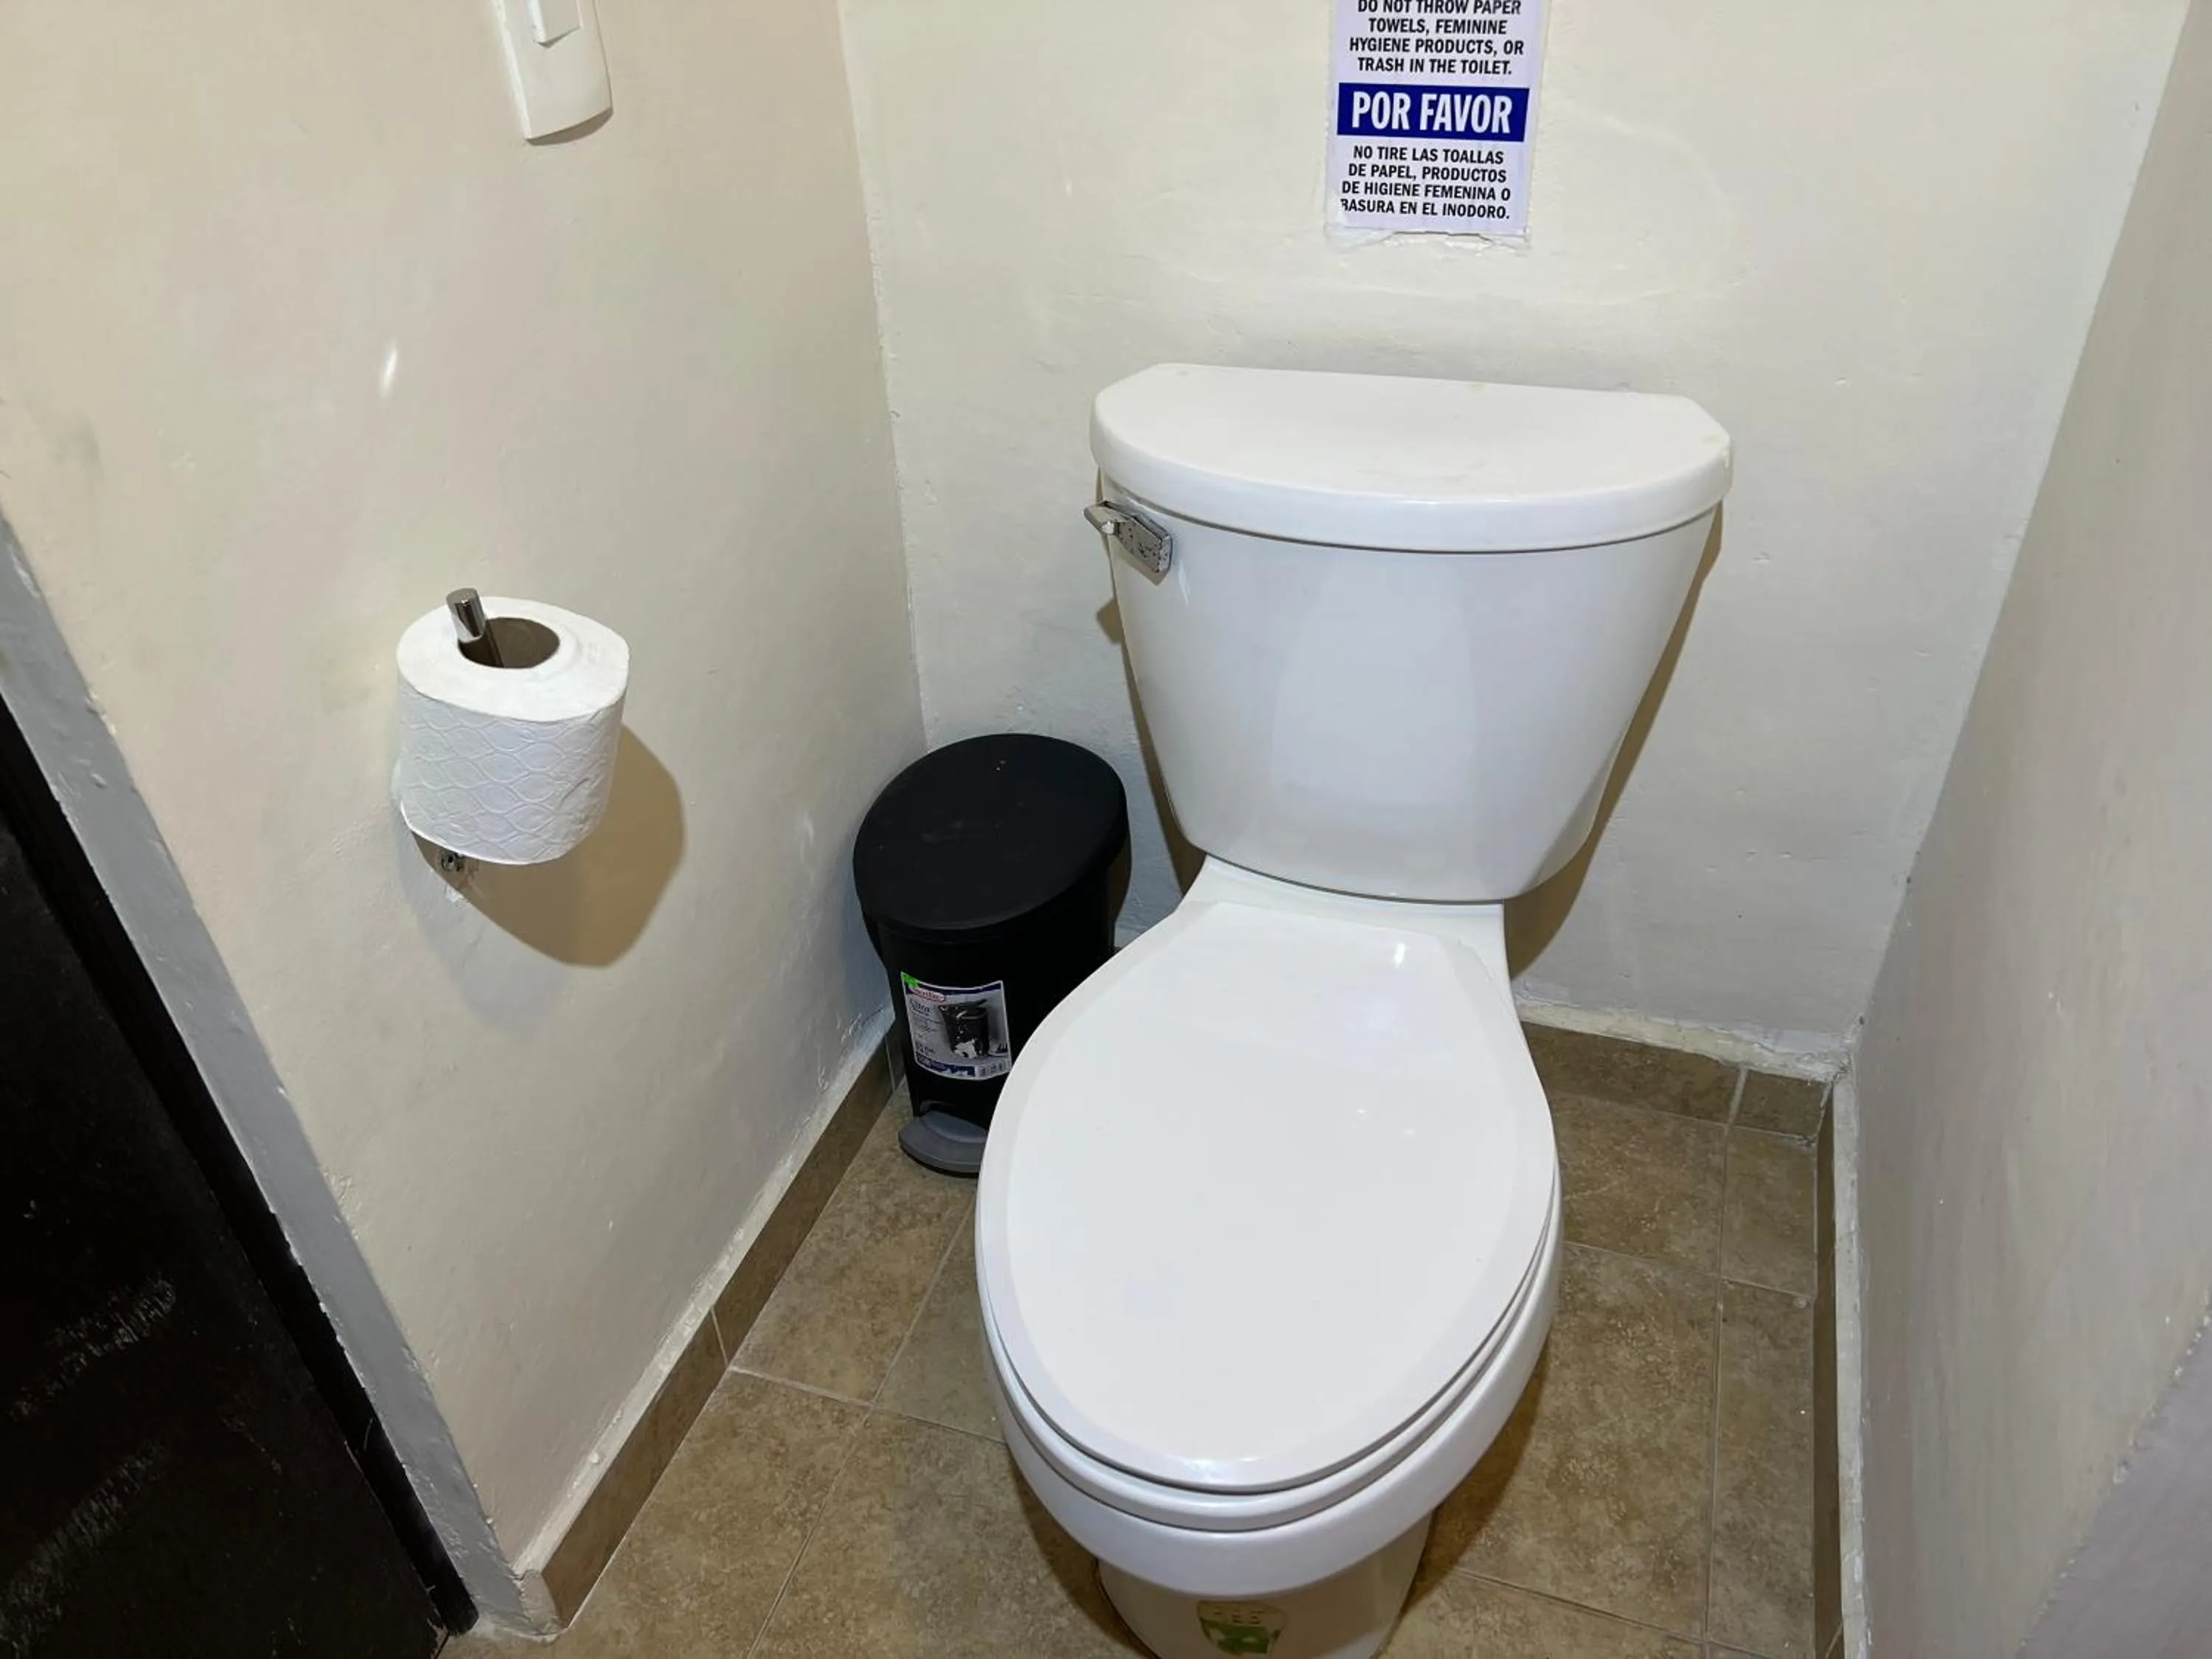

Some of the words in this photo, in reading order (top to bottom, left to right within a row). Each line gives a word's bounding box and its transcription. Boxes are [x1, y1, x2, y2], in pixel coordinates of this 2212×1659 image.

[1358, 0, 1377, 13] DO
[1383, 0, 1413, 13] NOT
[1416, 0, 1469, 14] THROW
[1473, 0, 1521, 15] PAPER
[1368, 17, 1430, 36] TOWELS,
[1436, 18, 1507, 35] FEMININE
[1349, 38, 1411, 52] HYGIENE
[1415, 38, 1498, 57] PRODUCTS,
[1503, 40, 1524, 55] OR
[1358, 57, 1404, 72] TRASH
[1409, 58, 1425, 73] IN
[1429, 59, 1456, 74] THE
[1461, 60, 1512, 75] TOILET.
[1352, 91, 1411, 131] POR
[1419, 93, 1512, 134] FAVOR
[1353, 145, 1373, 159] NO
[1377, 146, 1408, 161] TIRE
[1412, 147, 1438, 161] LAS
[1443, 148, 1504, 164] TOALLAS
[1349, 163, 1366, 176] DE
[1371, 164, 1416, 181] PAPEL,
[1422, 166, 1506, 183] PRODUCTOS
[1342, 181, 1360, 194] DE
[1364, 181, 1420, 197] HIGIENE
[1424, 184, 1495, 201] FEMENINA
[1500, 187, 1511, 201] O
[1399, 201, 1417, 215] EN
[1422, 202, 1438, 216] EL
[1442, 203, 1509, 219] INODORO.
